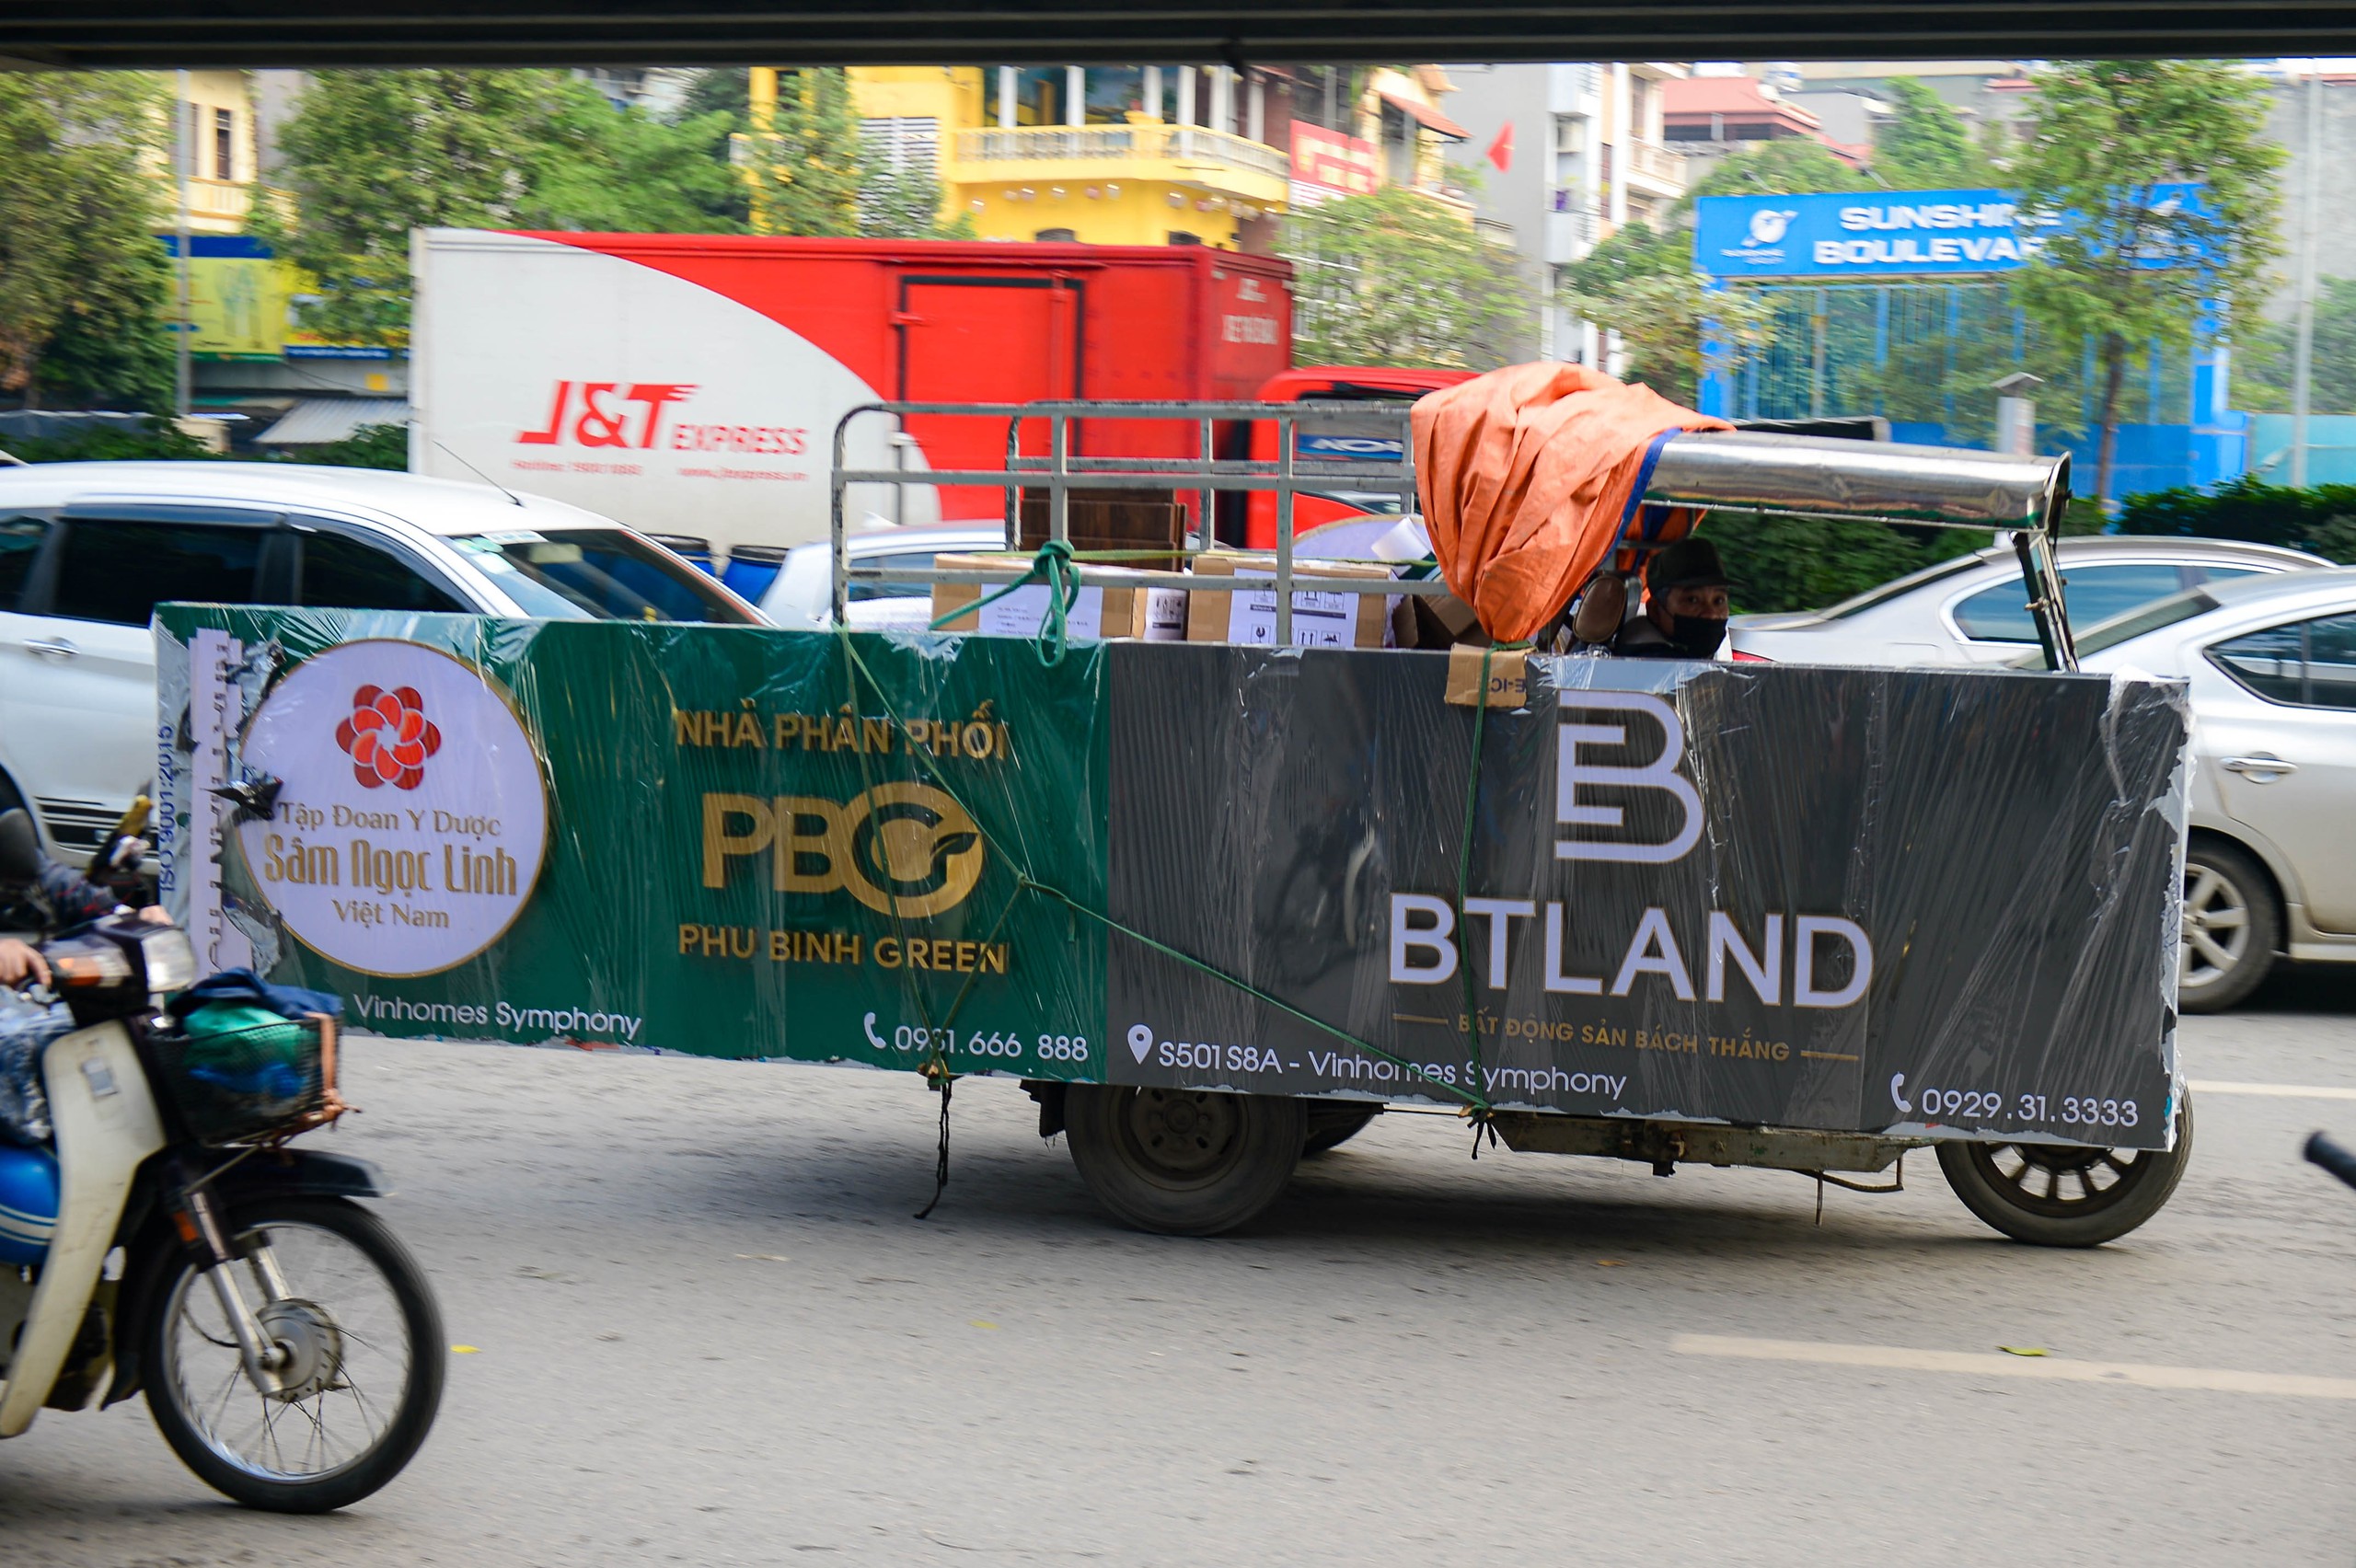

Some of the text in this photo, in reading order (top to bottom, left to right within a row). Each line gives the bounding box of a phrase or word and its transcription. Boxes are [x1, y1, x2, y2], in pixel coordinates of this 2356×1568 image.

[1813, 236, 2078, 265] BOULEVAR
[514, 379, 699, 449] J&T
[672, 423, 808, 455] EXPRESS
[158, 724, 176, 892] ISO 9001:2015
[278, 802, 502, 841] Tập Đoan Y Dược
[263, 834, 517, 897] Sâm Ngọc Linh
[331, 899, 450, 928] Việt Nam
[678, 923, 1009, 975] PHU BINH GREEN
[1389, 893, 1875, 1008] BTLAND
[353, 994, 642, 1041] Vinhomes Symphony
[1458, 1005, 1790, 1061] BẤT ĐỘNG SẢN BÁCH THẮNG
[1158, 1041, 1220, 1070] S501
[1226, 1045, 1284, 1075] S8A
[1308, 1050, 1456, 1085] Vinhomes
[1464, 1060, 1627, 1101] Symphony
[1922, 1088, 2139, 1127] 0929.31.3333
